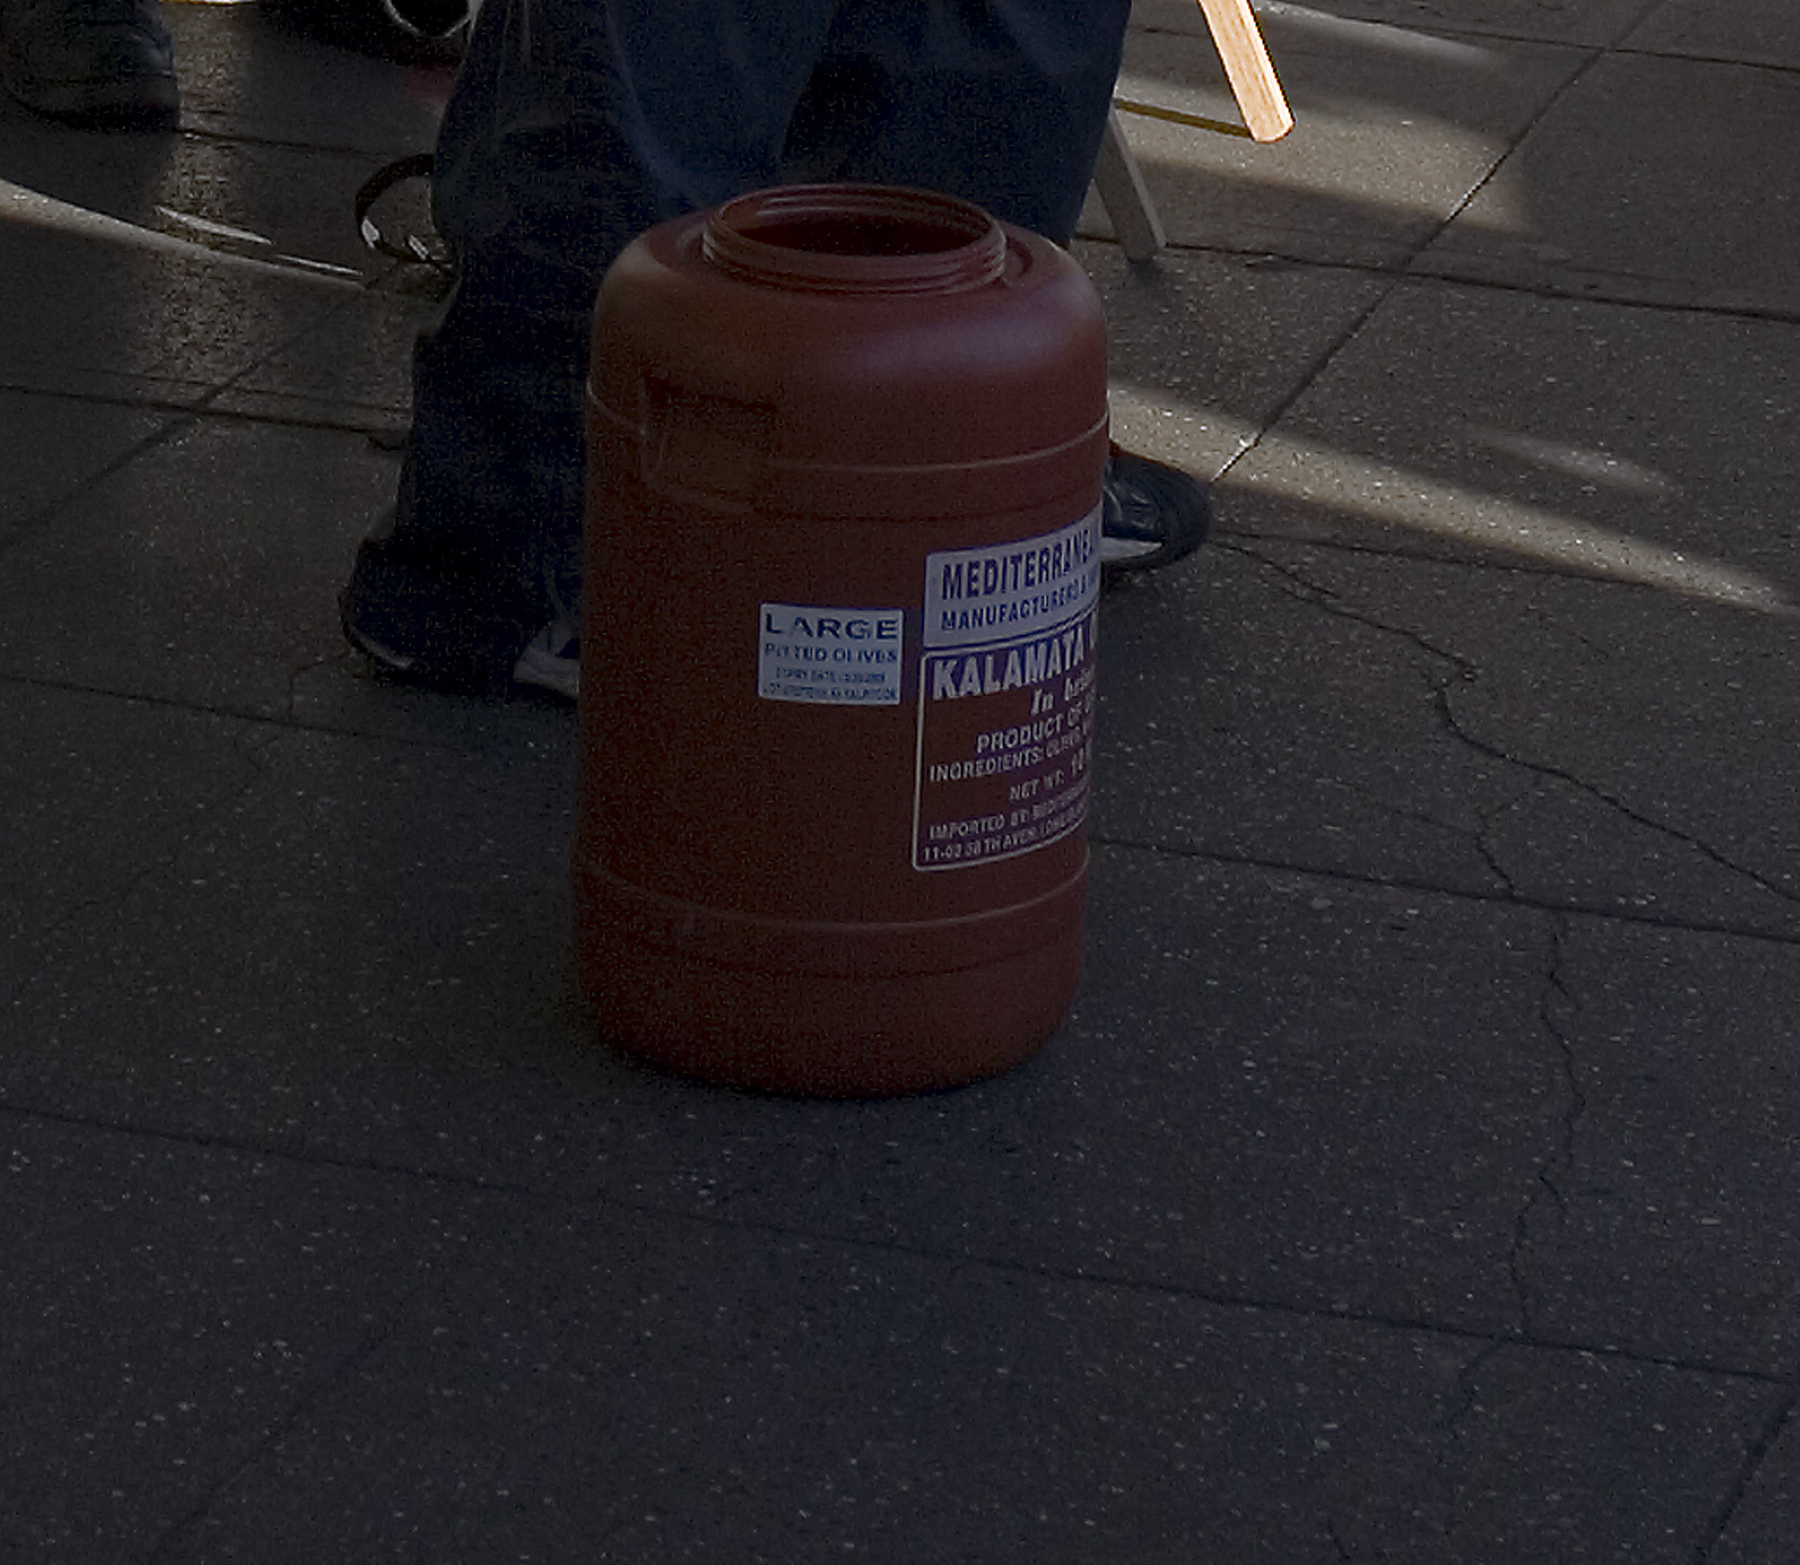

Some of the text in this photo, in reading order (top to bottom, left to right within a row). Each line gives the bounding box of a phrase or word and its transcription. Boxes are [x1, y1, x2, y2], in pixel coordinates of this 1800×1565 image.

[765, 612, 898, 640] LARGE
[932, 624, 1085, 701] KALAMATA
[1030, 687, 1055, 717] In
[976, 713, 1064, 754] PRODUCT
